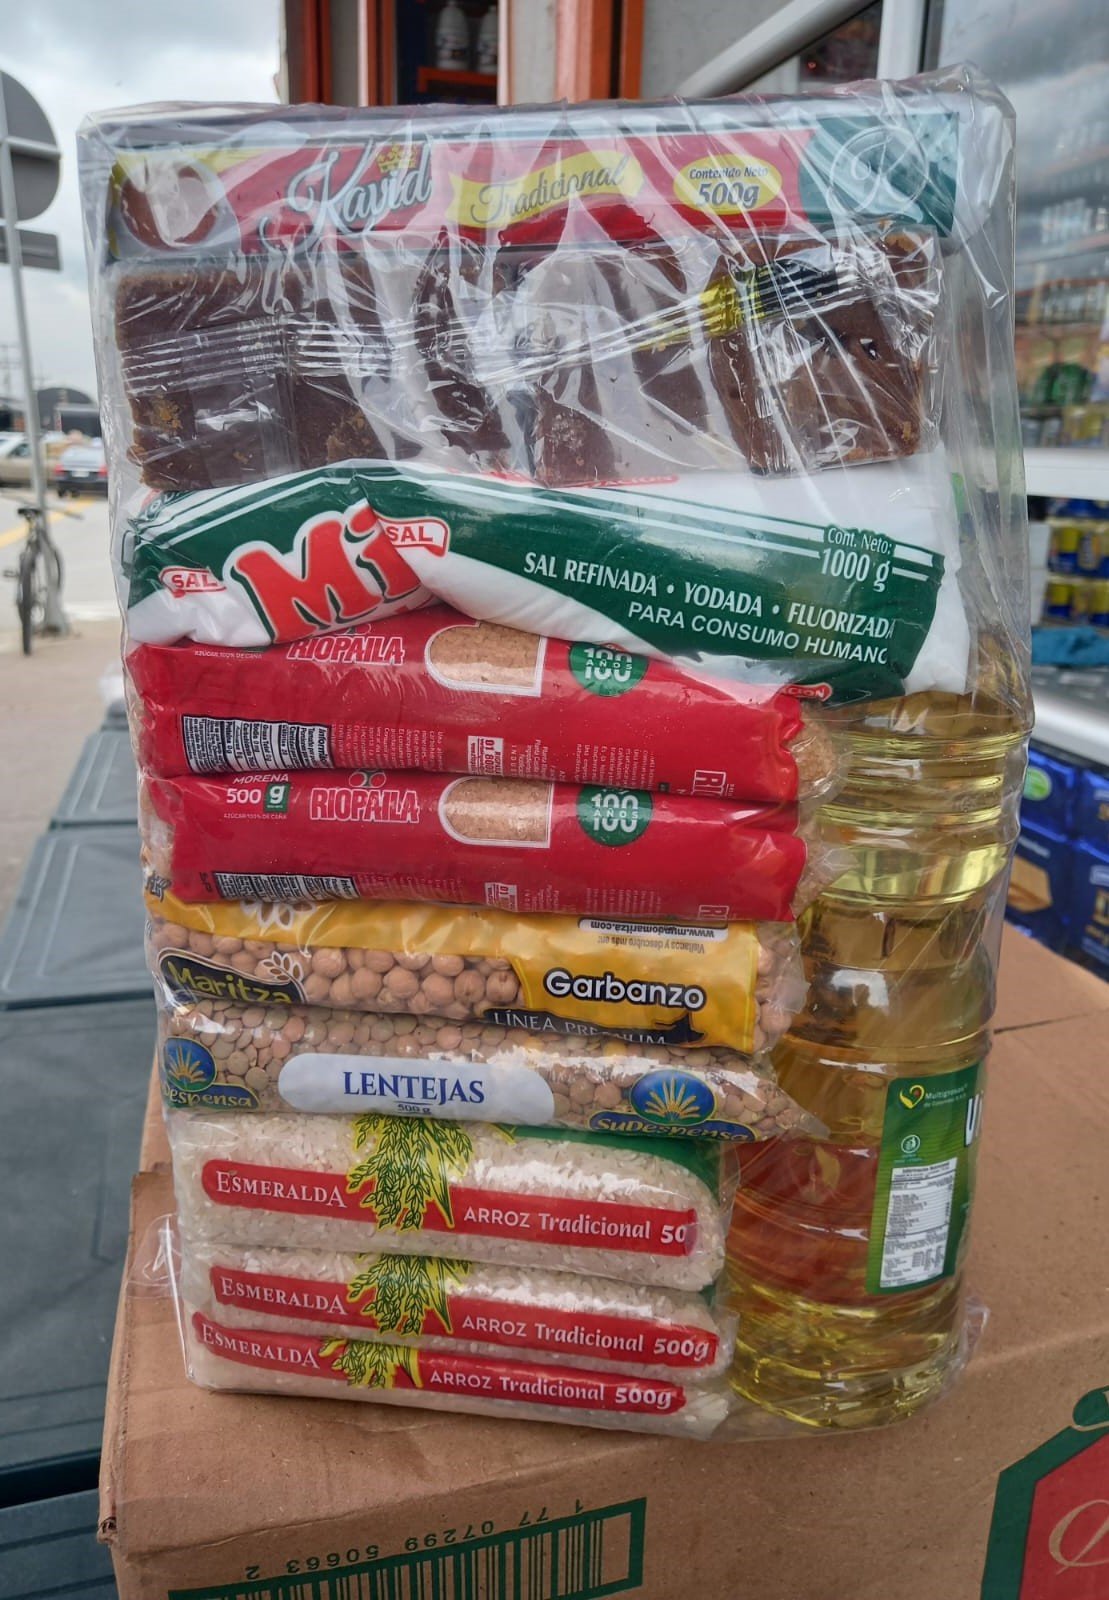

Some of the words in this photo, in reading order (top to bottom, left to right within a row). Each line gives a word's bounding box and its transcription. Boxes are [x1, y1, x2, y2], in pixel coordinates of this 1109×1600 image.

[262, 143, 433, 246] Kavid
[470, 156, 626, 223] Tradicional
[697, 180, 760, 209] 500g
[387, 523, 435, 546] SAL
[827, 527, 857, 549] Cont.
[860, 532, 893, 555] Neto:
[171, 572, 219, 593] SAL
[523, 551, 558, 580] SAL
[563, 556, 658, 598] REFINADA
[684, 582, 763, 618] YODADA
[820, 547, 869, 583] 1000
[873, 562, 890, 594] g
[628, 601, 685, 630] PARA
[690, 616, 800, 650] CONSUMO
[286, 636, 405, 666] RIOPAILA
[226, 787, 262, 805] 500
[269, 785, 286, 805] g
[232, 773, 289, 785] MORENA
[309, 787, 420, 824] RIOPAILA
[592, 807, 640, 820] AÑOS
[590, 920, 716, 938] www.mundomaritza.com
[167, 961, 293, 1004] Maritza
[545, 969, 705, 1011] Garbanzo
[494, 1010, 557, 1032] LÍNEA
[564, 1022, 666, 1045] PREIUM
[343, 1071, 485, 1105] LENTEJAS
[215, 1171, 347, 1209] ESMERALDA
[464, 1206, 530, 1229] ARROZ
[538, 1212, 650, 1240] Tradicional
[660, 1224, 687, 1244] 50
[220, 1278, 347, 1316] ESMERALDA
[201, 1323, 319, 1369] ESMERALDA
[462, 1314, 527, 1337] ARROZ
[535, 1322, 644, 1353] Tradicional
[653, 1337, 709, 1360] 500g
[430, 1368, 492, 1391] ARROZ
[499, 1376, 605, 1401] Tradicional
[614, 1386, 673, 1409] 500g
[518, 1507, 550, 1526] 77
[405, 1520, 495, 1551] 07299
[245, 1565, 259, 1581] 2
[286, 1544, 380, 1574] 50663
